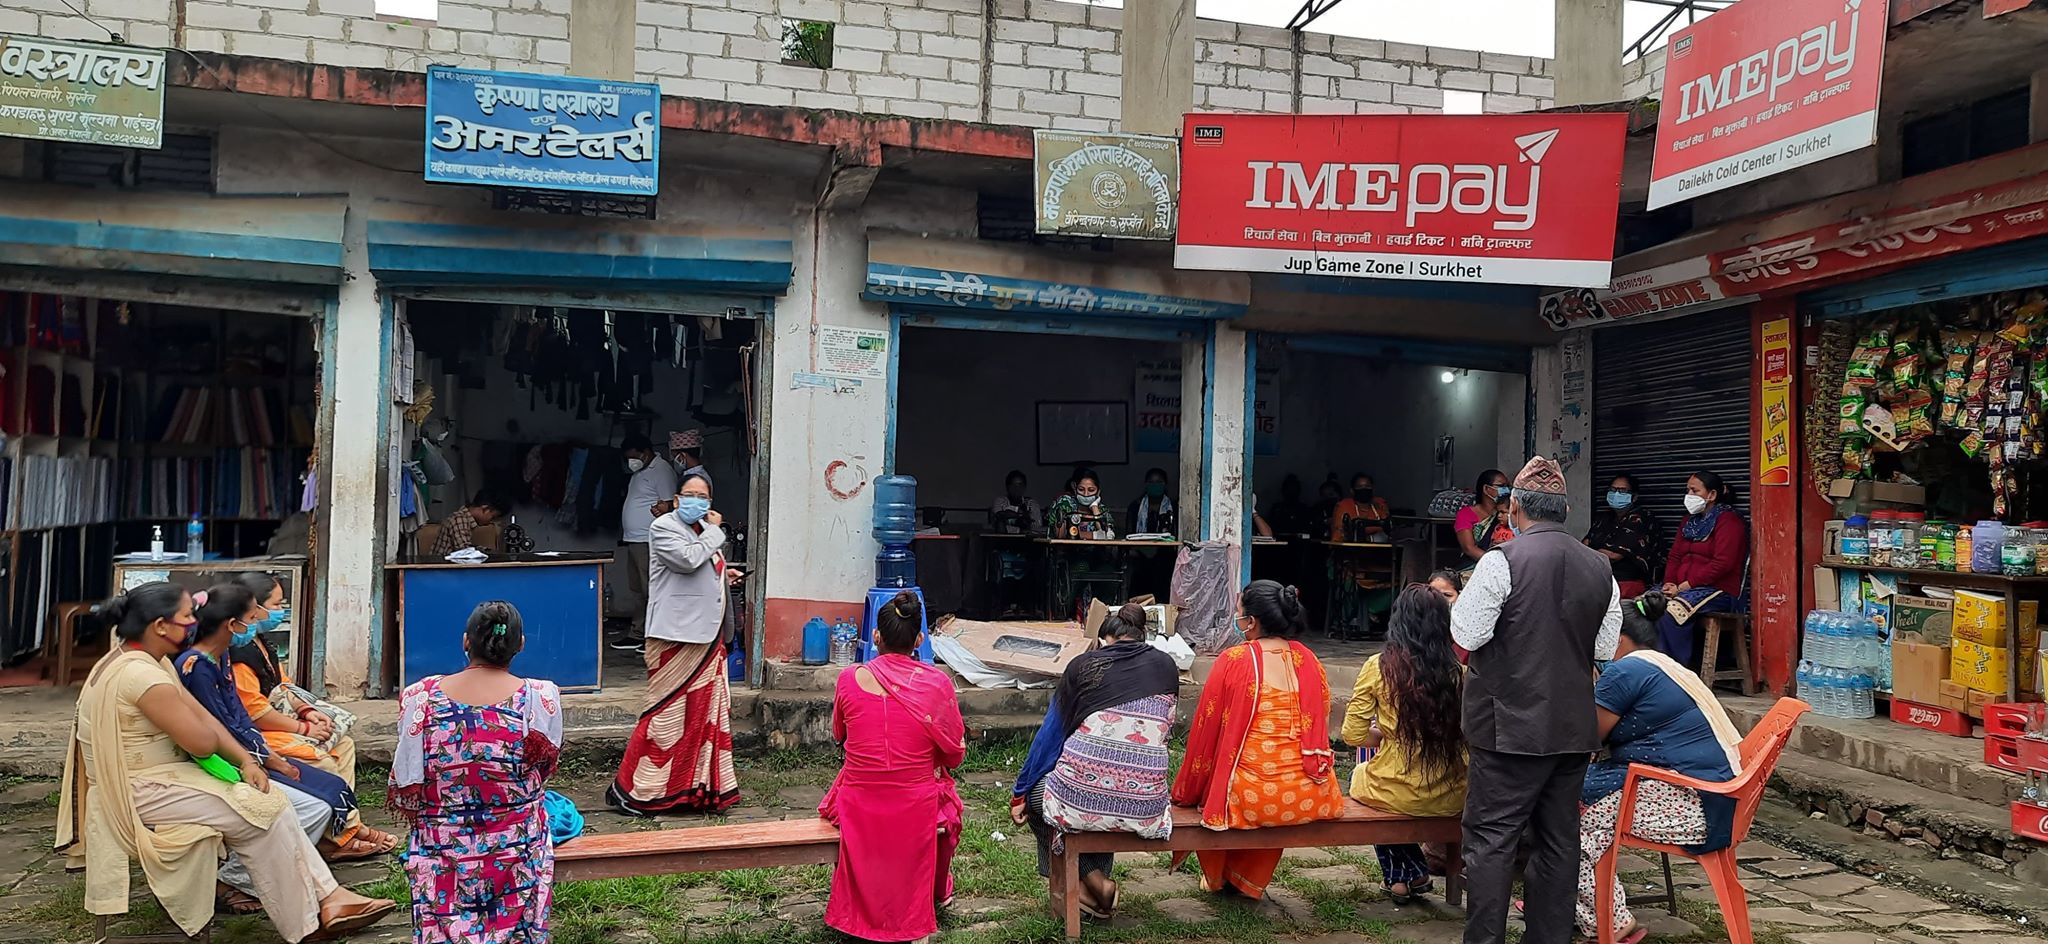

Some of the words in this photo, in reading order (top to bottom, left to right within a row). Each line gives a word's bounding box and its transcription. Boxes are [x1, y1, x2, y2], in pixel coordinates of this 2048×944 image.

[475, 83, 539, 114] कृष्णा
[1199, 129, 1221, 137] IME
[1678, 168, 1714, 192] Dailekh
[1716, 160, 1740, 181] Cold
[1741, 152, 1777, 173] Center
[1786, 133, 1832, 159] Surkhet
[1244, 227, 1275, 241] रिचार्ज
[1277, 230, 1298, 242] सेवा
[1312, 231, 1331, 243] बिल
[1334, 231, 1372, 246] भुक्तानी
[1386, 234, 1413, 247] हवाई
[1415, 233, 1445, 247] टिकट
[1460, 236, 1485, 249] मनि
[1284, 256, 1313, 275] Jup
[1316, 257, 1361, 273] Game
[1366, 259, 1404, 275] Zone
[1419, 261, 1483, 279] Surkhet
[1601, 291, 1659, 319] GAME
[1655, 280, 1712, 309] ZONE
